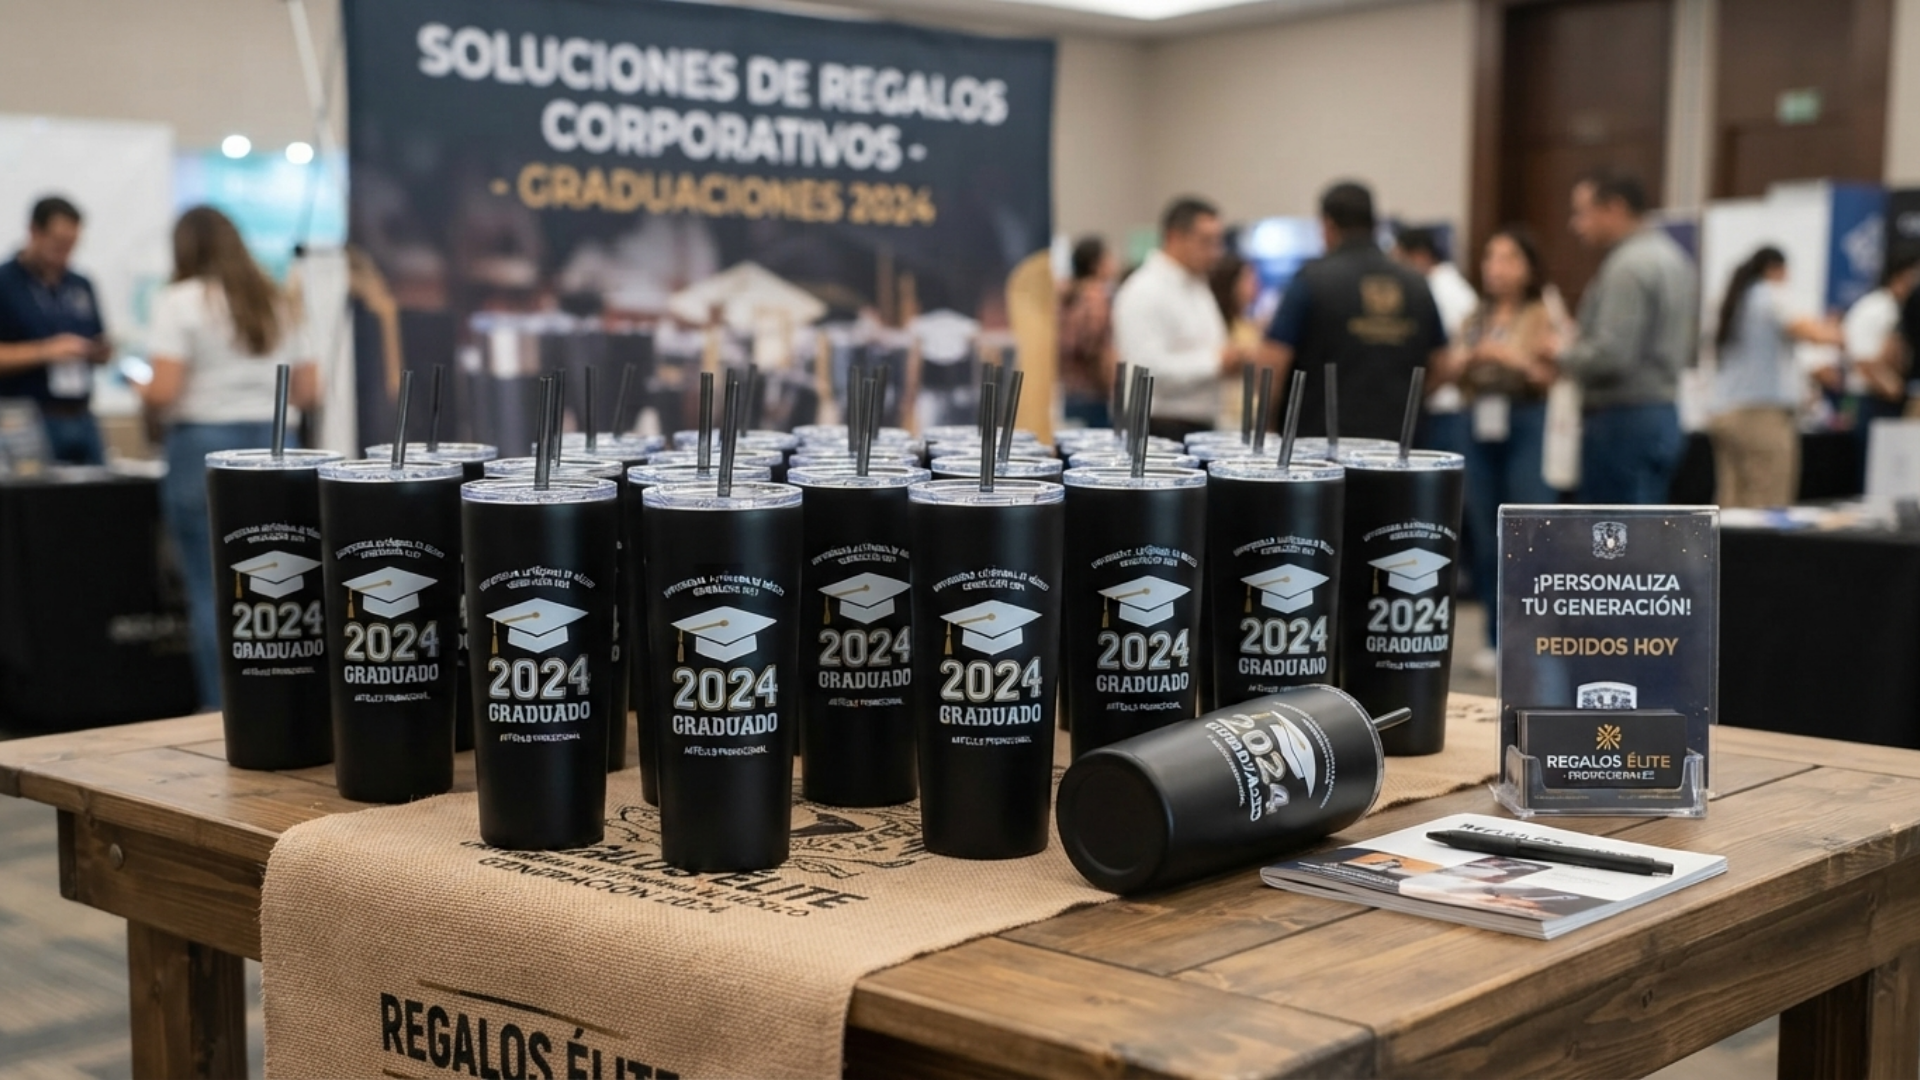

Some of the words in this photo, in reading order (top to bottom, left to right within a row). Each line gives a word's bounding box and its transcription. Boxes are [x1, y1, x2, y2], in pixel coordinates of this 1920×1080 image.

[417, 22, 739, 103] SOLUCIONES
[746, 56, 809, 108] DE
[819, 60, 1008, 125] REGALOS
[541, 99, 902, 171] CORPORATIVOS
[517, 163, 843, 223] GRADUACIONES
[849, 182, 935, 227] 2024
[1534, 574, 1680, 594] ¡PERSONALIZA
[232, 600, 324, 640] 2024
[1367, 596, 1449, 633] 2024
[1522, 598, 1547, 616] TU
[1554, 595, 1691, 616] GENERACIÓN!
[344, 620, 440, 661] 2024
[819, 626, 911, 667] 2024
[1097, 628, 1190, 670] 2024
[1240, 616, 1328, 655] 2024
[1536, 637, 1628, 656] PEDIDOS
[1634, 638, 1679, 656] HOY
[344, 663, 439, 684] GRADUADO
[488, 654, 591, 700] 2024
[672, 665, 778, 711] 2024
[818, 668, 911, 690] GRADUADO
[940, 656, 1042, 702] 2024
[1096, 672, 1189, 693] GRADUADO
[488, 701, 591, 723] GRADUADO
[672, 712, 778, 736] GRADUADO
[939, 703, 1041, 726] GRADUADO
[1547, 754, 1622, 768] REGALOS
[1627, 752, 1671, 768] ÉLITE
[380, 992, 553, 1080] REGALOS
